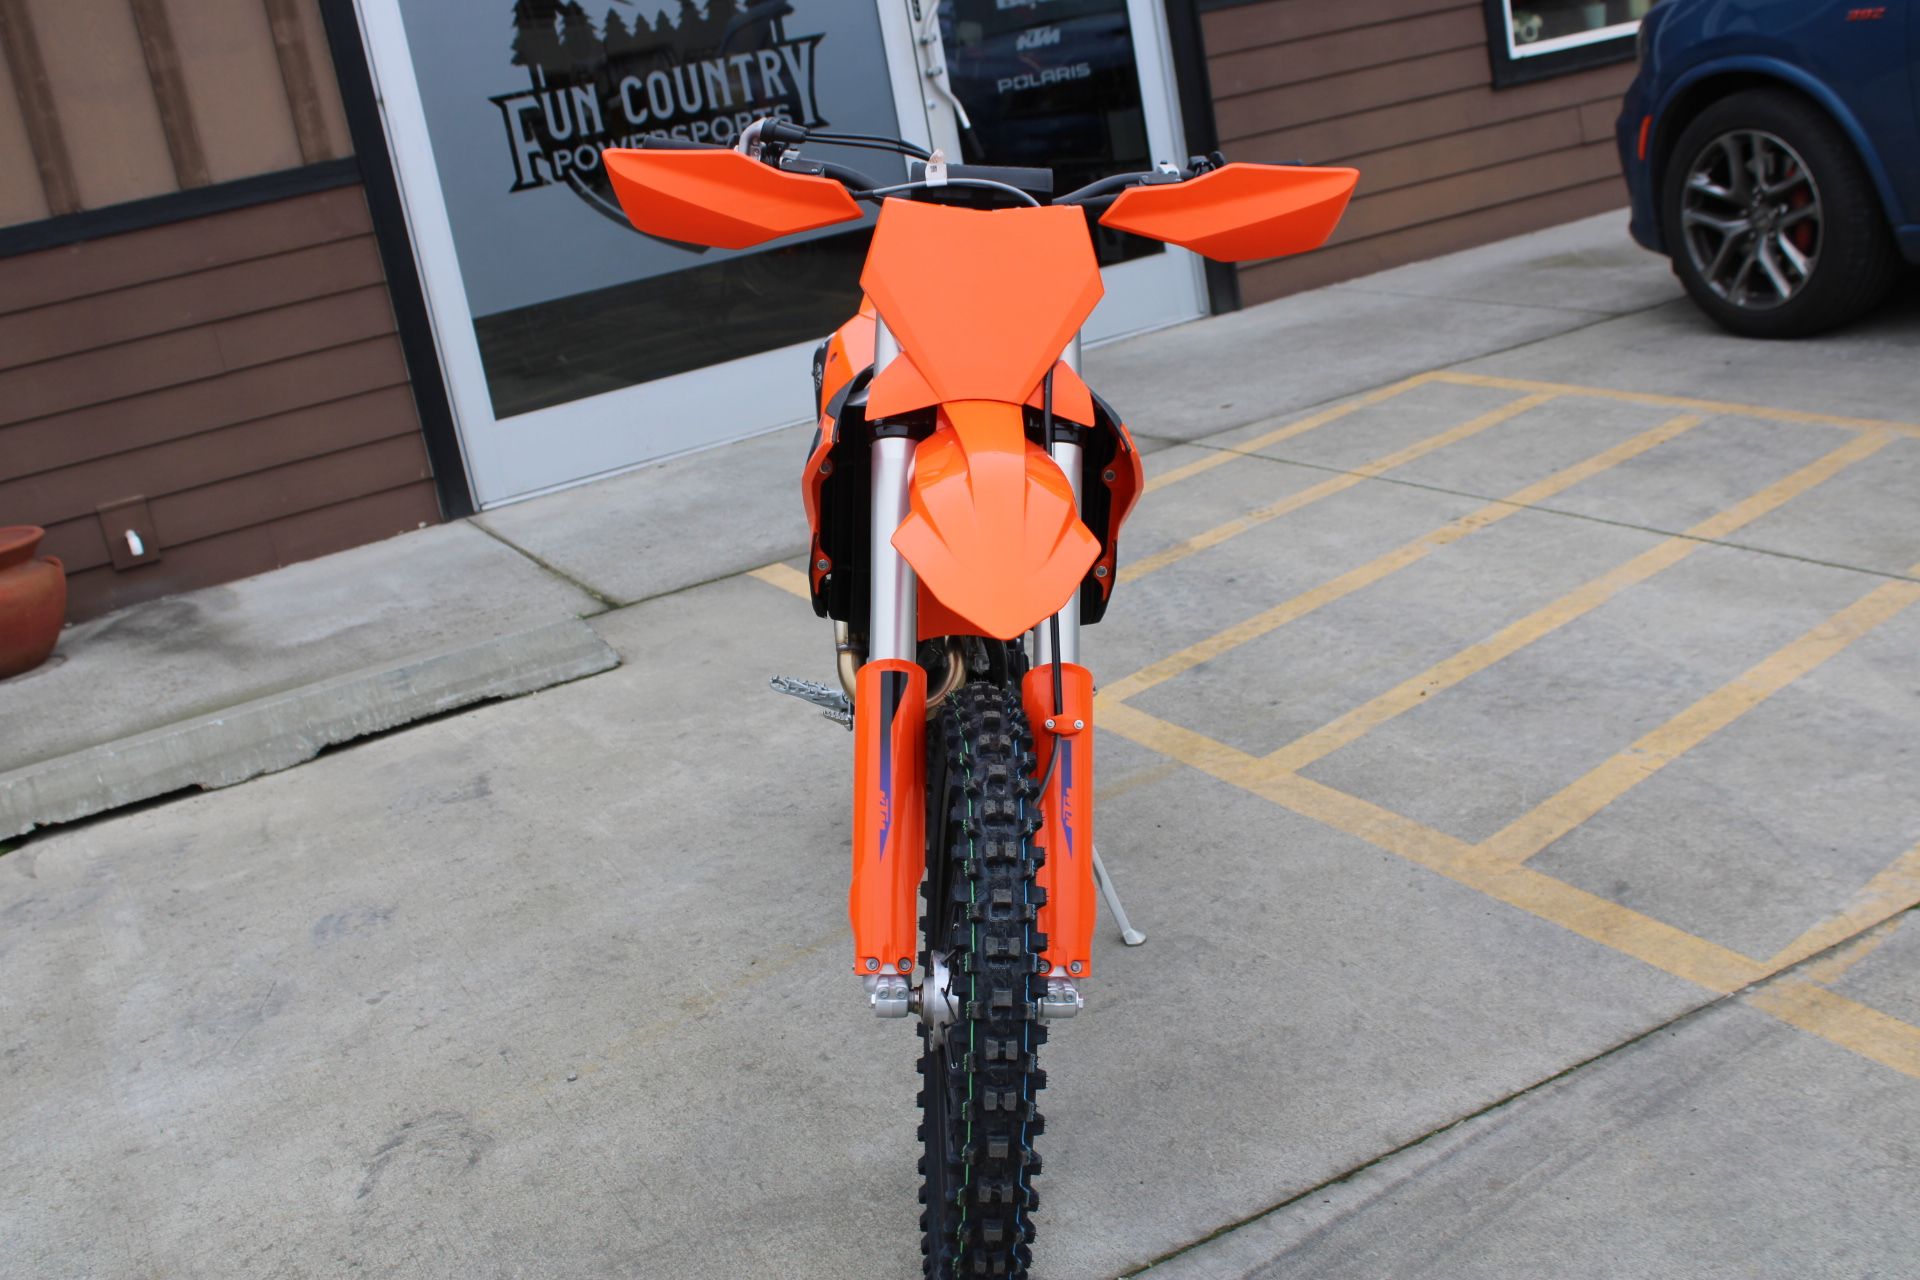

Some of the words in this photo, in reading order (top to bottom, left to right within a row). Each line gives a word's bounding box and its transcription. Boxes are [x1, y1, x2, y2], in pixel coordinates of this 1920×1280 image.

[1016, 26, 1061, 51] KTM
[998, 62, 1091, 94] POLARIS
[504, 83, 604, 184] FUN
[620, 41, 816, 125] COUNTRY
